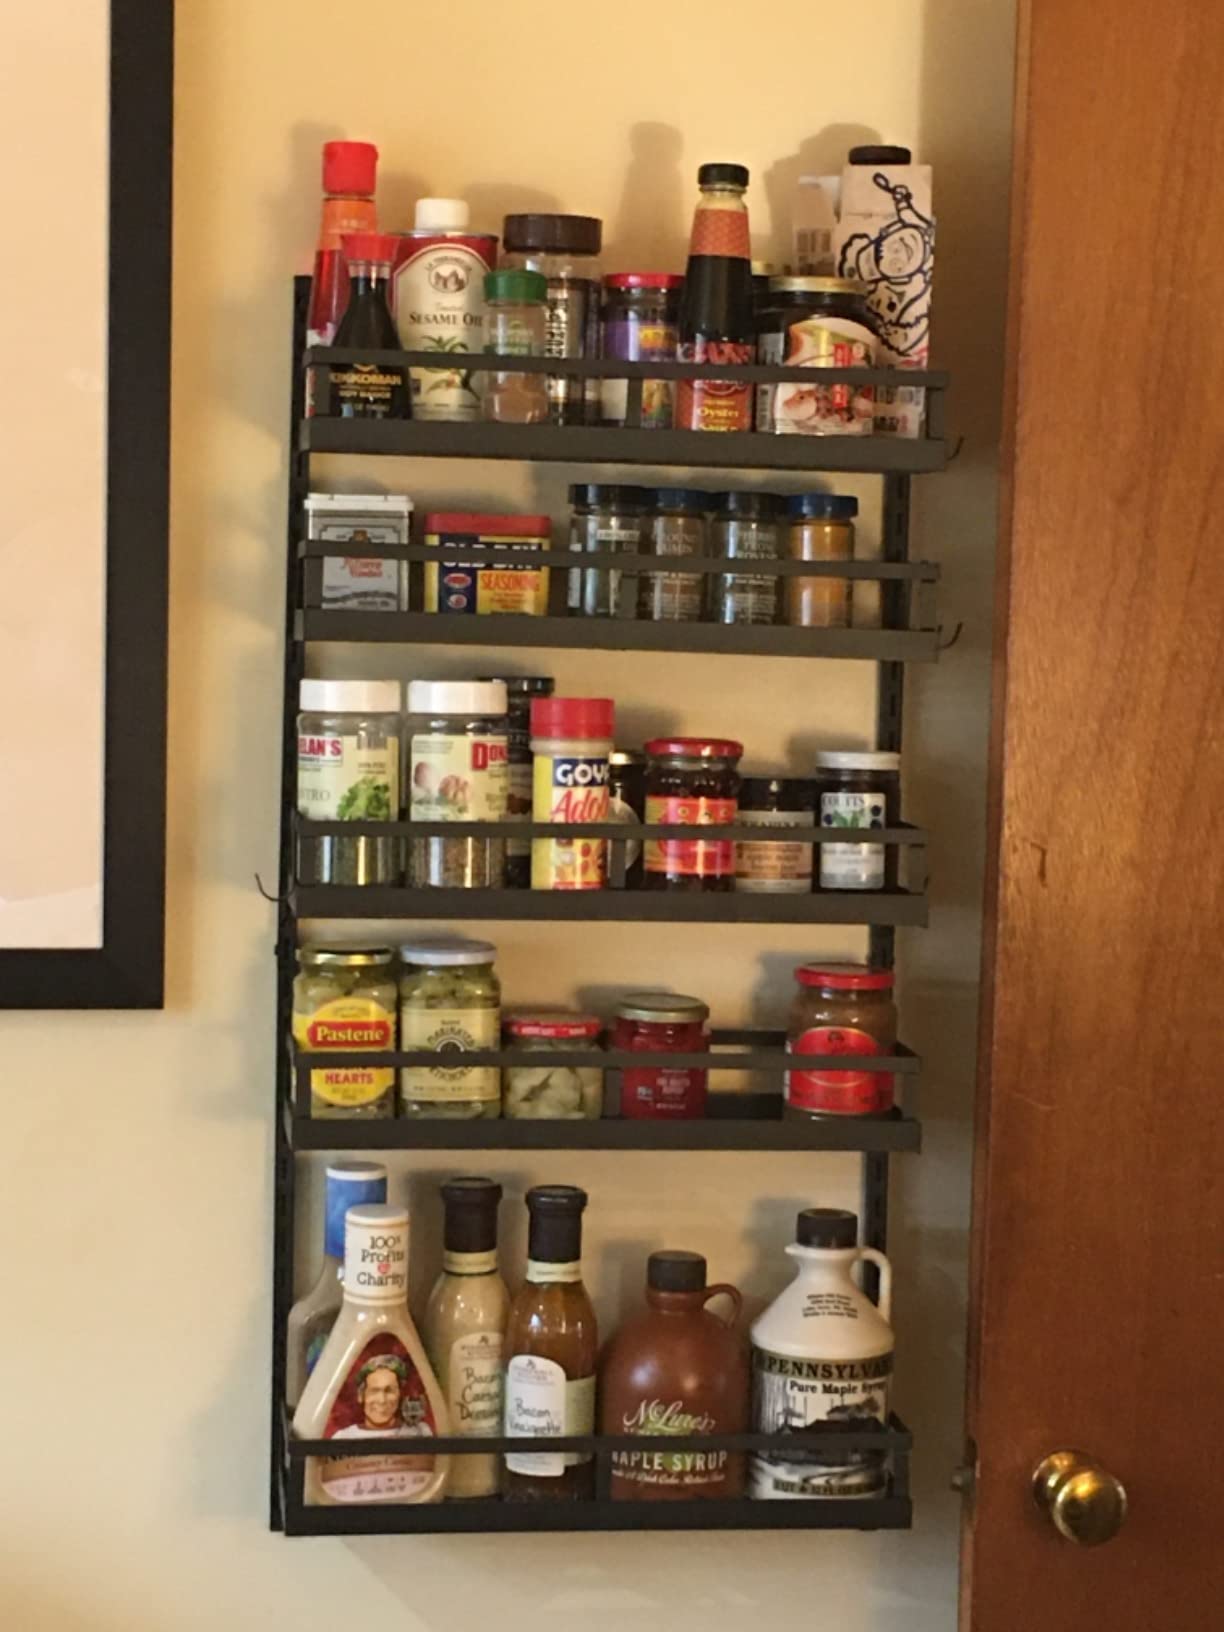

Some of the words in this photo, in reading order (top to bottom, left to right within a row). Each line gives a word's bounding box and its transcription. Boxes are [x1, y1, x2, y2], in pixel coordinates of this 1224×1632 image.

[316, 1024, 385, 1042] Pastene
[324, 1072, 374, 1085] HEARTS
[789, 1380, 818, 1394] Pure
[821, 1383, 858, 1398] Maple
[671, 1450, 728, 1471] SYRUP
